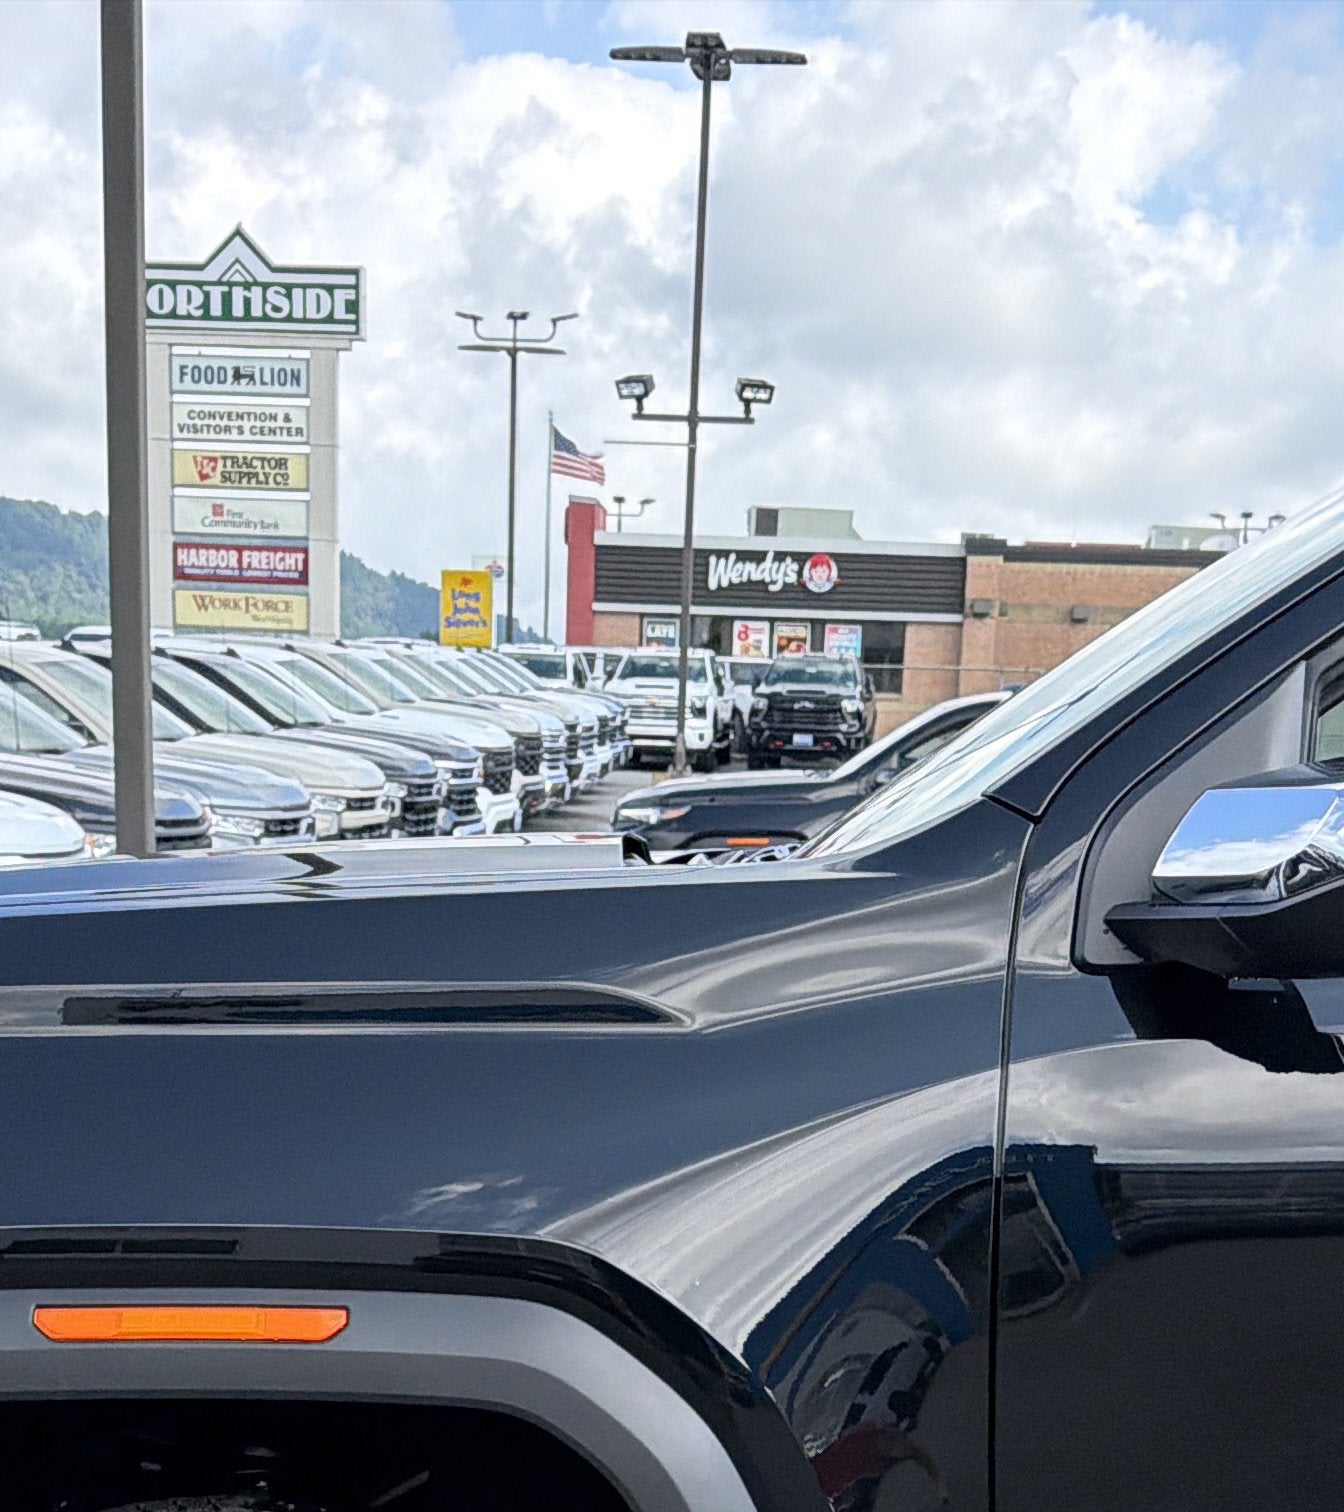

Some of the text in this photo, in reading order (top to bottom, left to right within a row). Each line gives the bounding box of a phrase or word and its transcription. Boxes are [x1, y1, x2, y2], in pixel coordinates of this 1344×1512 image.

[146, 283, 357, 319] ORTHSIDE
[179, 364, 302, 387] FOOD LION
[187, 409, 293, 423] CONVENTION &
[177, 423, 304, 437] VISITOR'S CENTER
[221, 456, 289, 471] TRACTOR
[220, 470, 272, 485] SUPPLY
[177, 548, 305, 571] HARBOR FREIGHT
[708, 549, 799, 592] Wendy's
